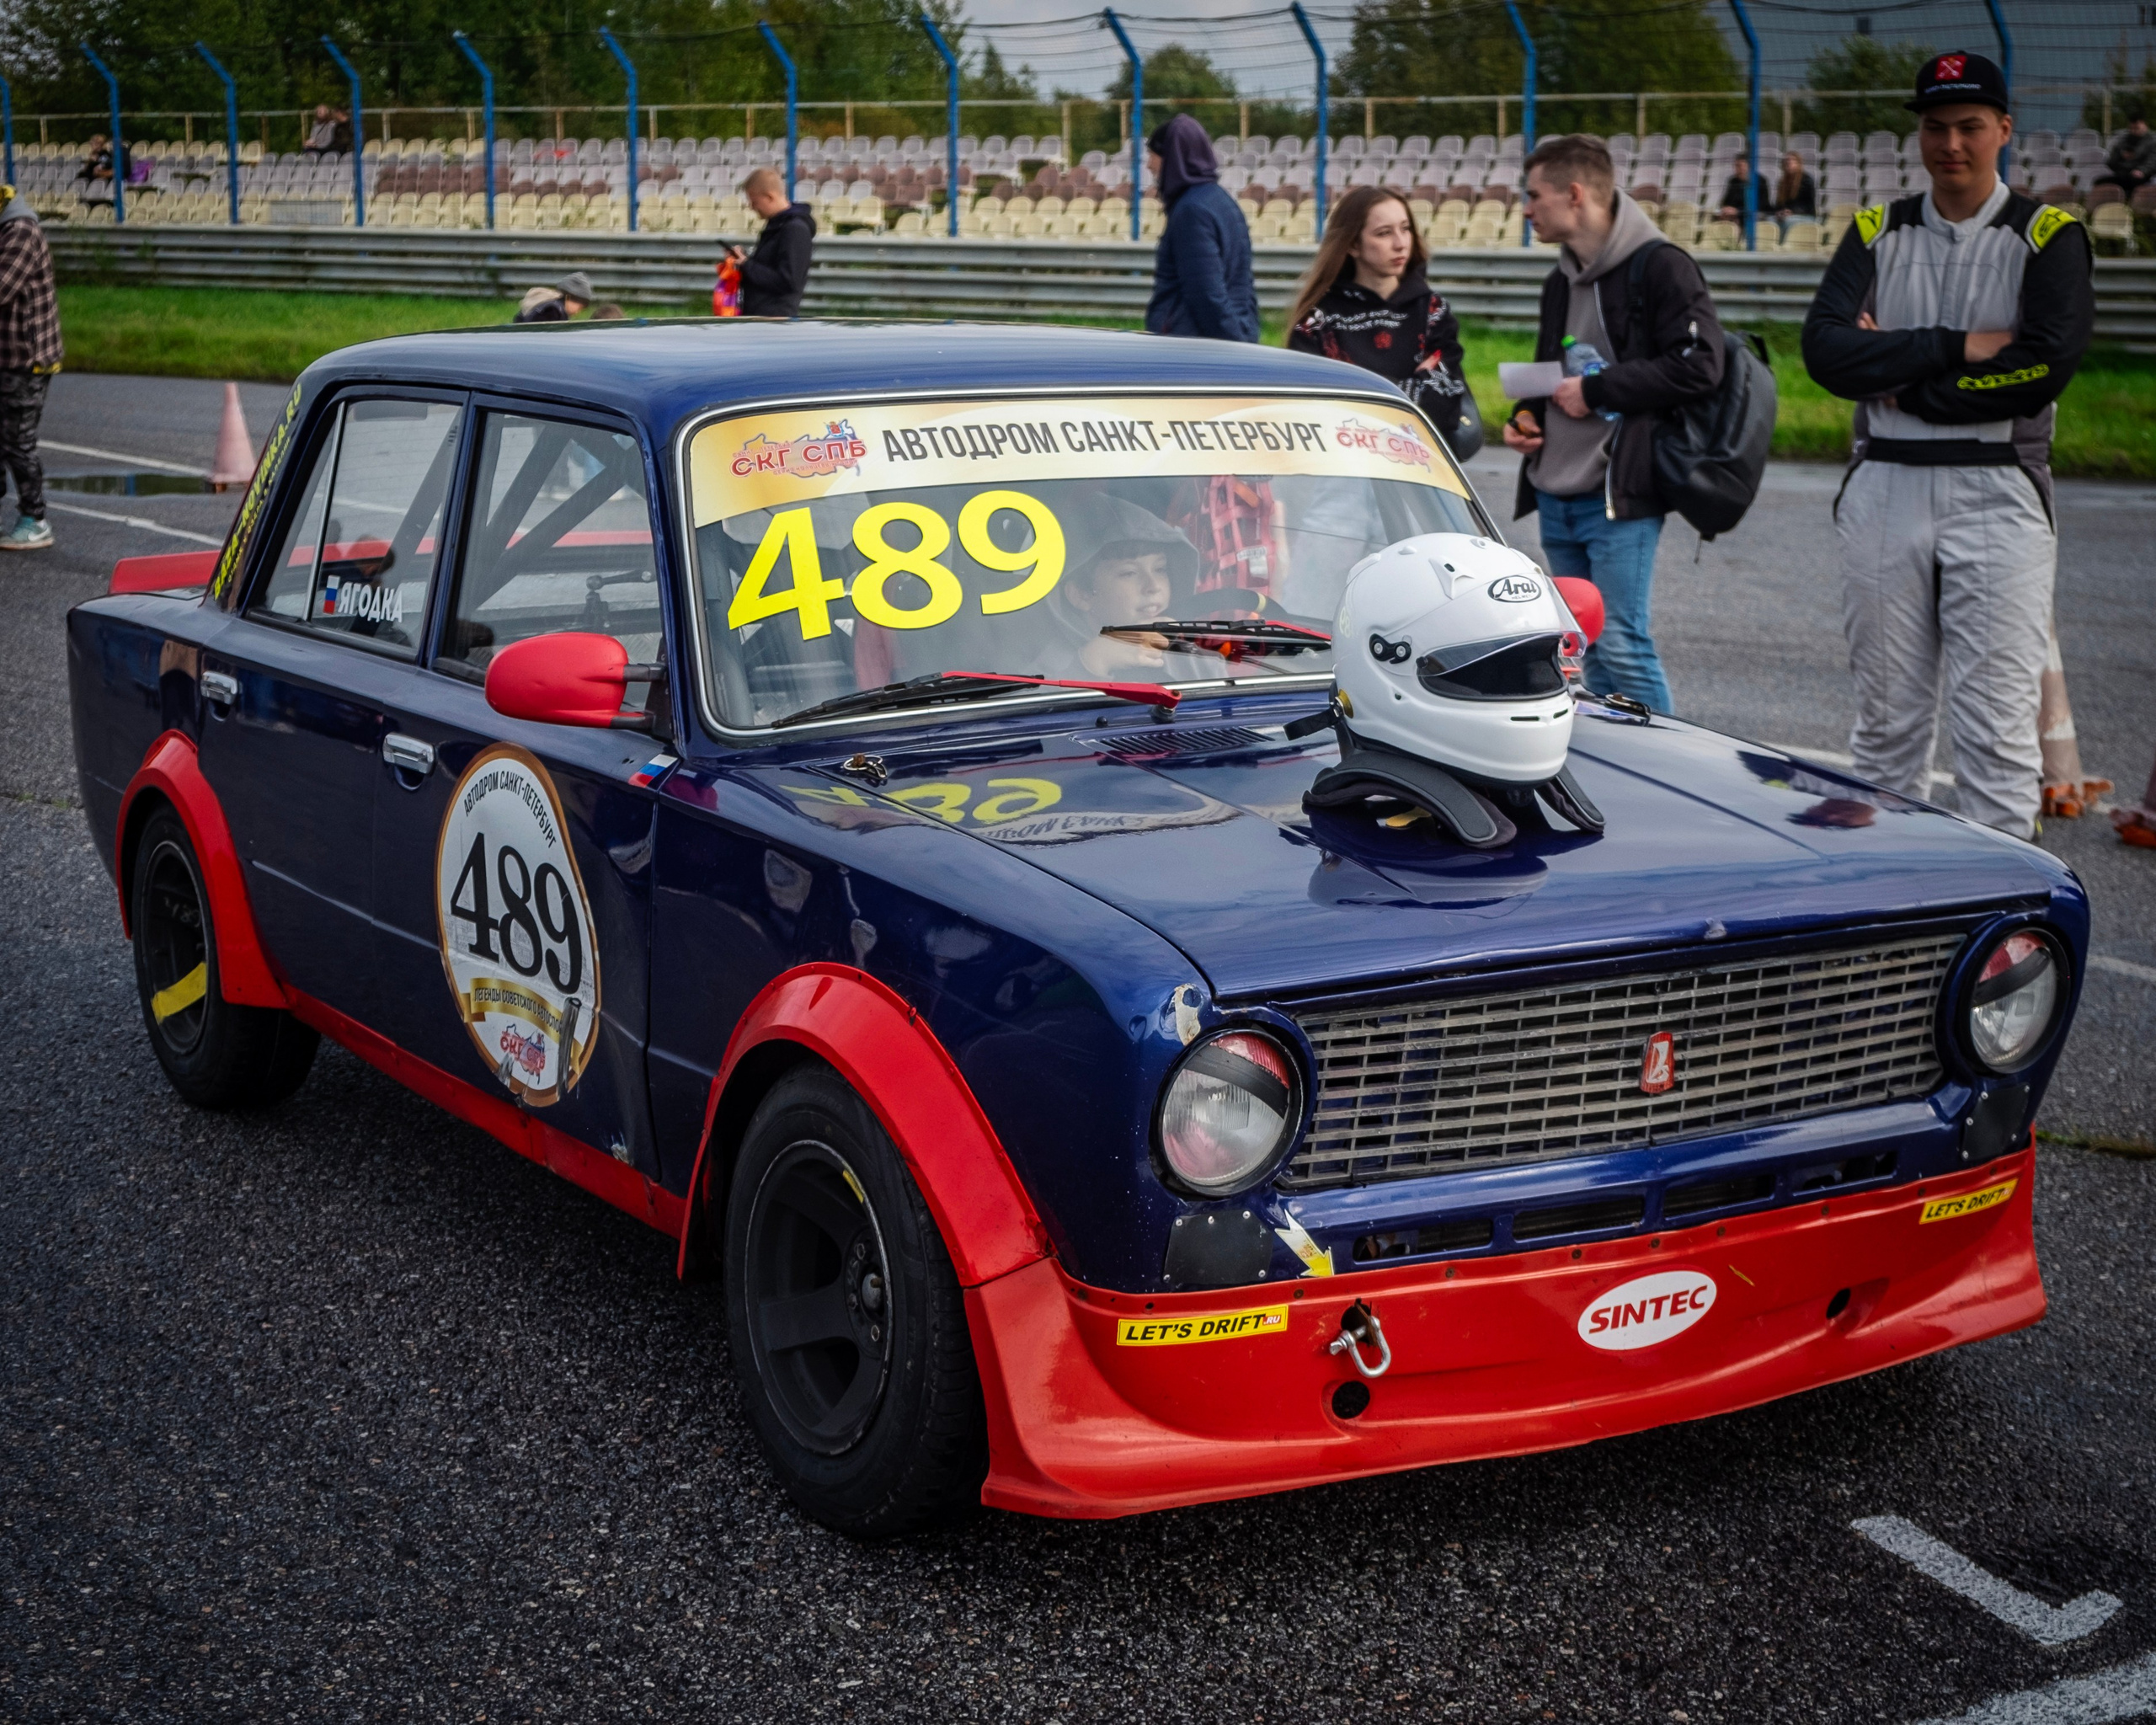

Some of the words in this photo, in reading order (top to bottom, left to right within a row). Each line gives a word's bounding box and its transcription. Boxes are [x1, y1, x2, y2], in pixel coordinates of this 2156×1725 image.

[730, 447, 792, 477] СКГ
[801, 438, 867, 464] СПБ
[883, 422, 1059, 462] АВТОДРОМ
[1060, 420, 1327, 453] САНКТ-ПЕТЕРБУРГ
[1336, 431, 1378, 450] СКГ
[728, 489, 1066, 640] 489
[338, 581, 403, 622] ЯГОДКА
[1495, 578, 1537, 598] Arai
[463, 770, 499, 817] АВТОДРОМ
[499, 770, 557, 849] САНКТ-ПЕТЕРБУРГ
[450, 832, 582, 995] 489
[474, 987, 501, 1003] ЛЕГЕНДЫ
[501, 989, 536, 1014] СОВЕТСКОГО
[536, 1001, 561, 1033] АВТОСПО
[1925, 1200, 1967, 1220] LET'S
[1967, 1187, 2012, 1210] DRIFT
[1588, 1284, 1708, 1334] SINTEC
[1124, 1323, 1193, 1341] LET'S
